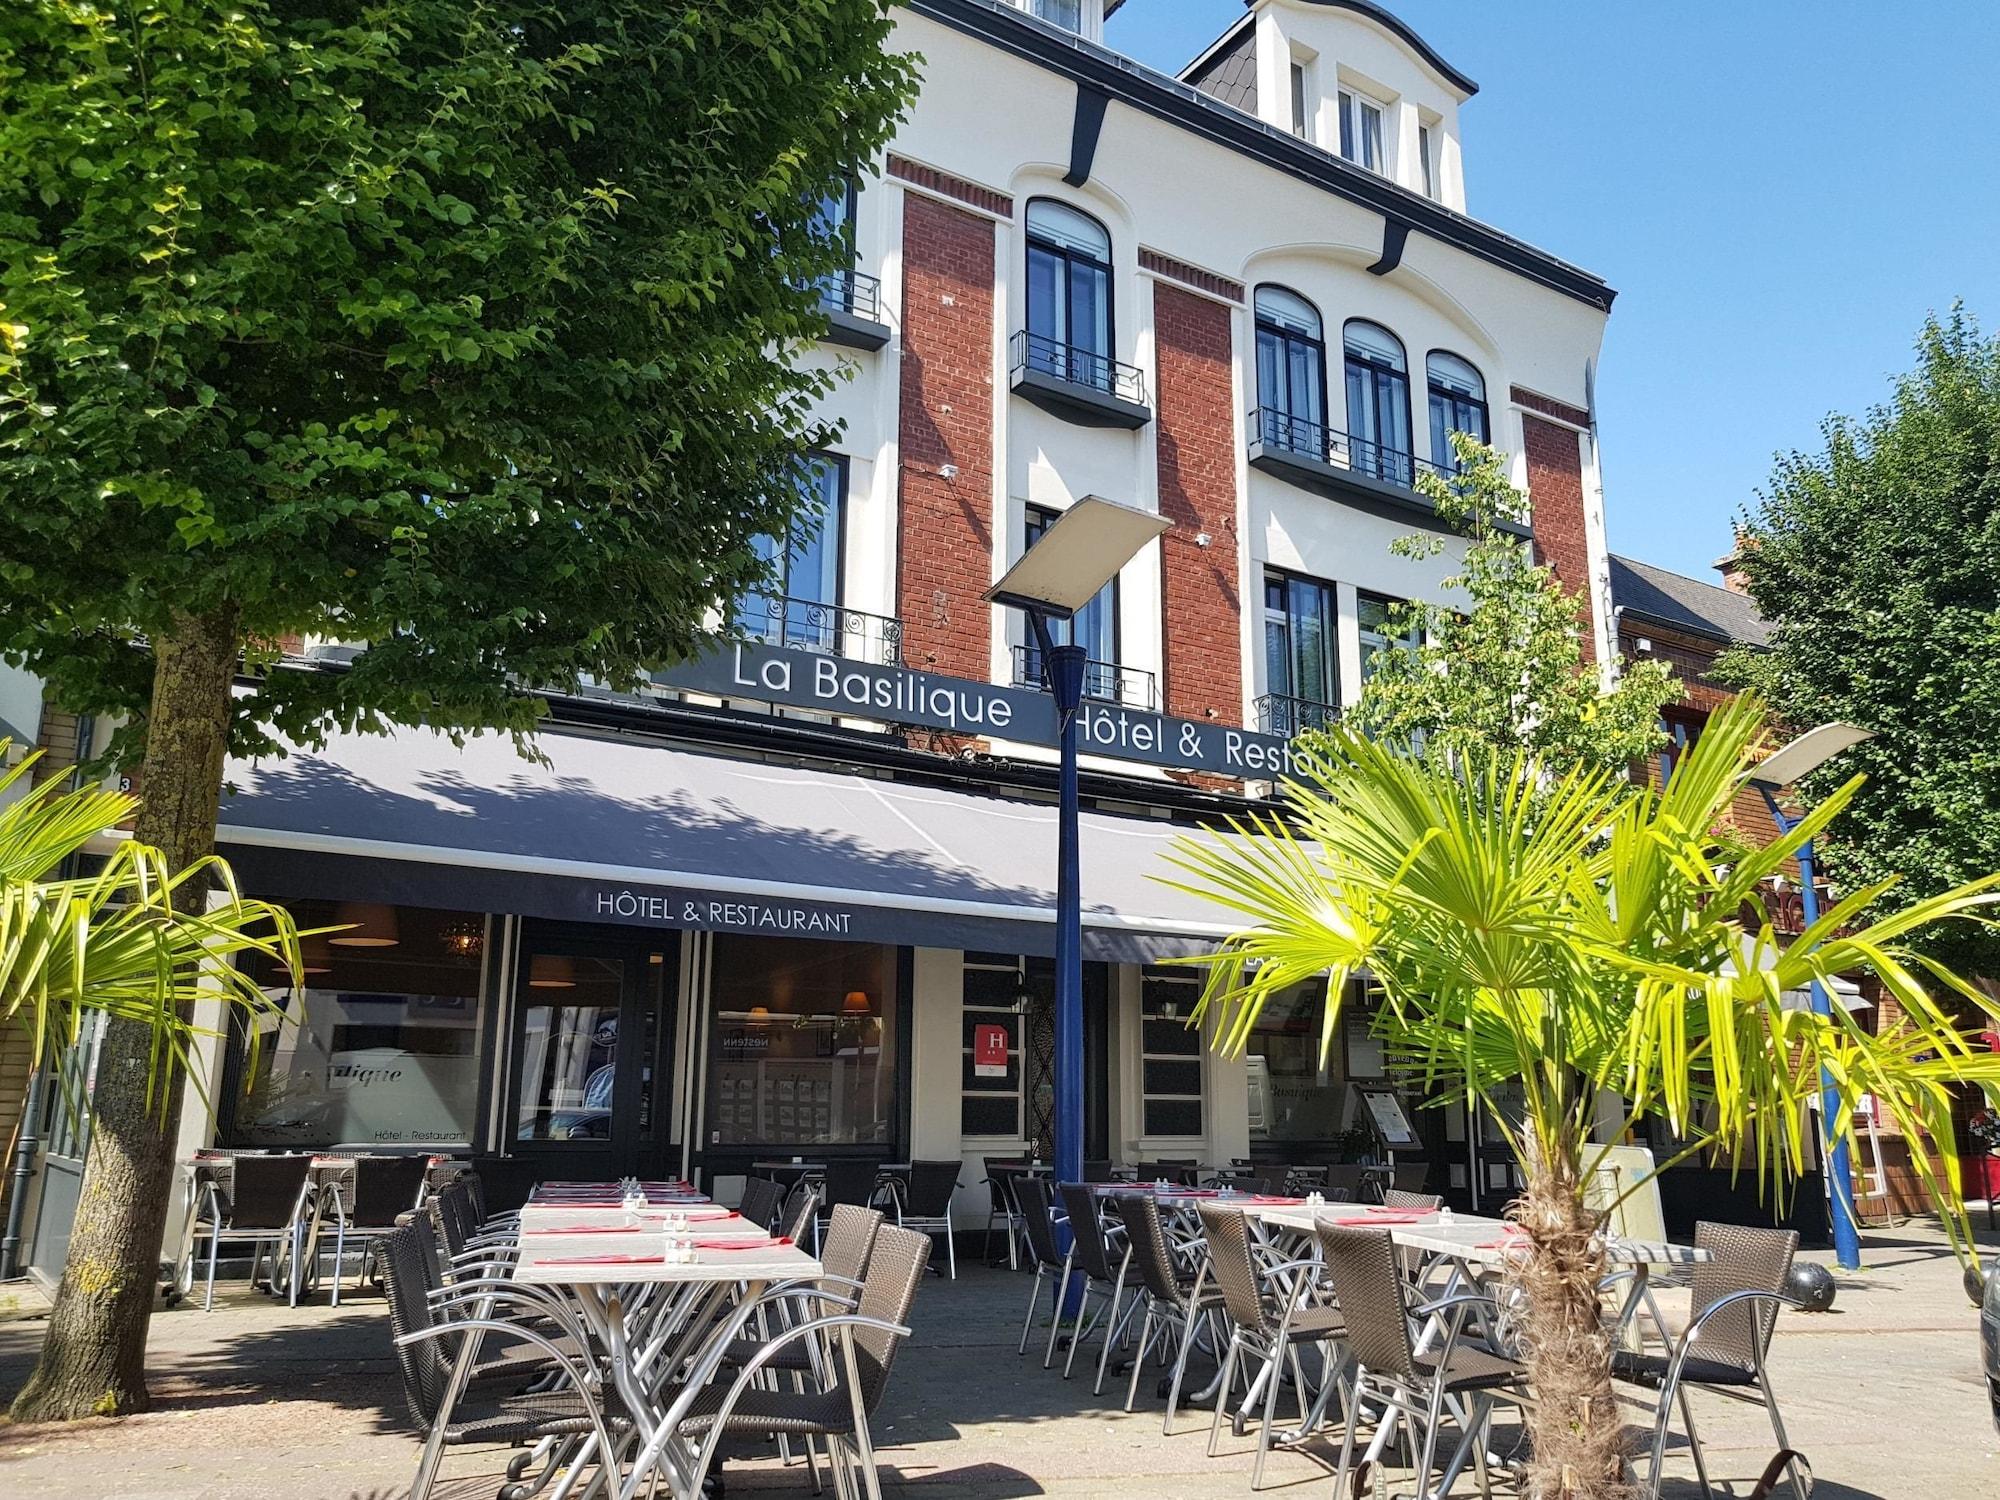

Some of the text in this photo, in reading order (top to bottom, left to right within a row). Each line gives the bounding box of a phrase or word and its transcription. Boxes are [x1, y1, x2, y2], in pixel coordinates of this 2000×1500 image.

[734, 644, 1012, 728] La Basilique
[1076, 704, 1163, 753] Hôtel
[1178, 722, 1204, 759] &
[597, 890, 851, 933] HÔTEL & RESTAURANT
[990, 1033, 1004, 1049] H
[374, 1130, 402, 1140] Hôtel
[412, 1131, 466, 1140] Restaurant
